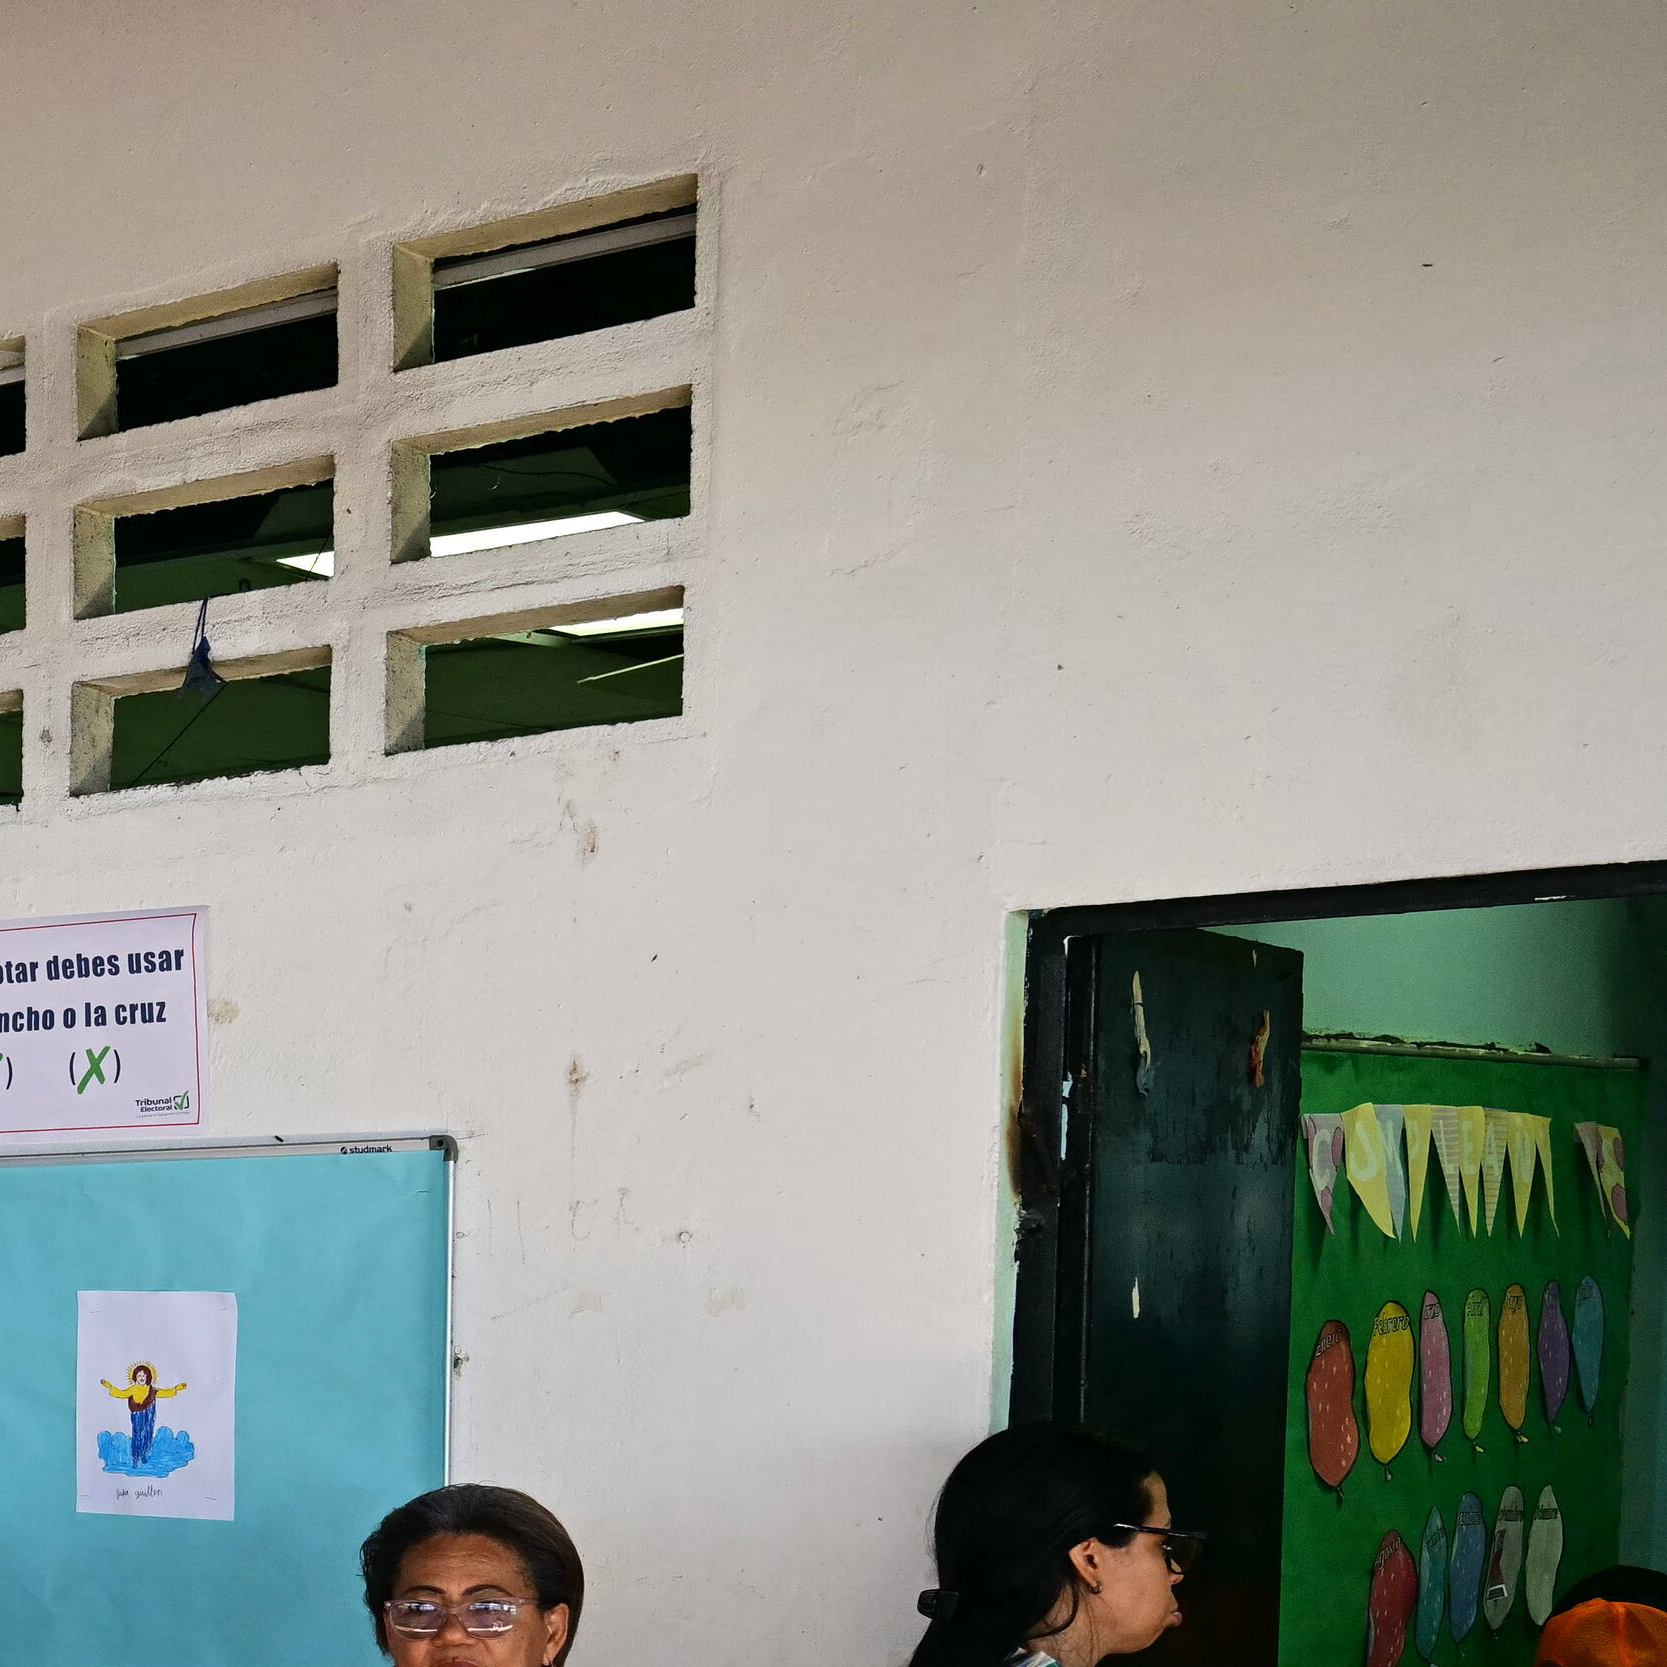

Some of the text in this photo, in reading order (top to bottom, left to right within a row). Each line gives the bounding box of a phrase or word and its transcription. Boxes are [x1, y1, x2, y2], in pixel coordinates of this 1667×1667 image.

[46, 953, 120, 981] debes
[127, 949, 184, 974] usar
[63, 1007, 76, 1028] o
[84, 1002, 107, 1027] la
[115, 1001, 167, 1025] cruz
[135, 1096, 172, 1106] Tribunal
[140, 1105, 172, 1113] Electoral
